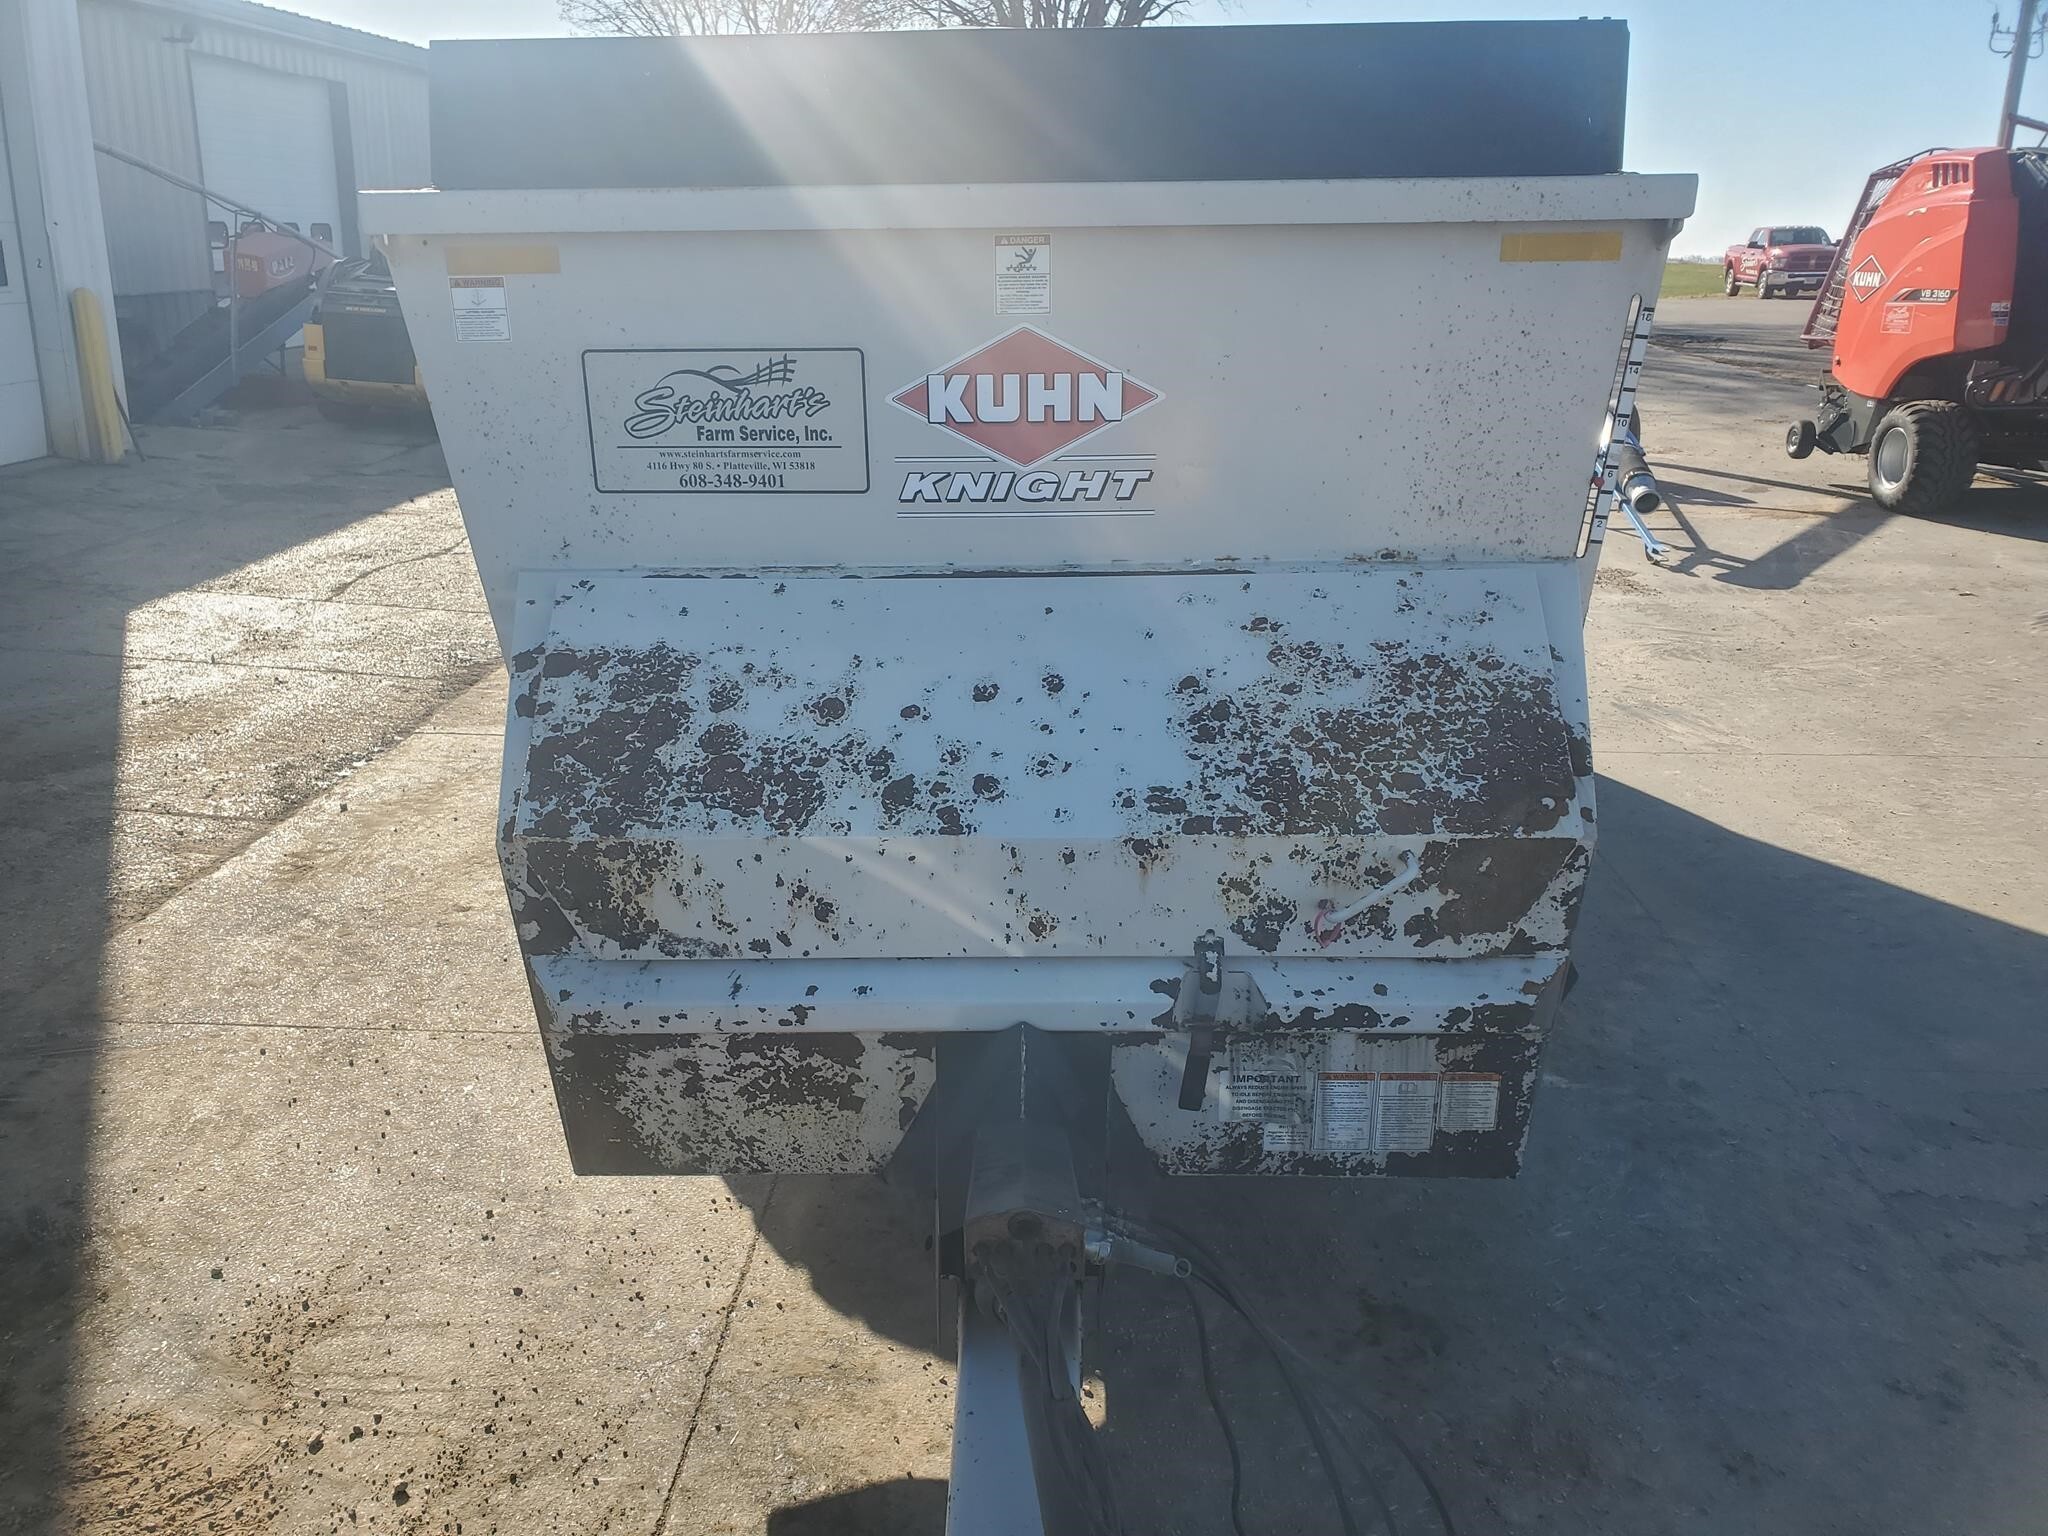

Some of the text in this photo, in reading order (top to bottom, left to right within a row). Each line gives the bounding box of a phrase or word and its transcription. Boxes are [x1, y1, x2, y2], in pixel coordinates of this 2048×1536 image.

[1009, 236, 1045, 245] DANGER
[1852, 271, 1882, 288] KUHN
[1921, 289, 1951, 298] VB 3160
[1628, 366, 1640, 376] 14
[926, 371, 1123, 424] KUHN
[623, 385, 831, 439] Steinhart's
[1616, 419, 1628, 428] 10
[696, 425, 833, 444] Farm Service, Inc.
[659, 449, 802, 459] www.steinhartsfarmservice.com
[646, 461, 816, 473] 4116 Hwy 80 S. Platteville, WI 53818
[1607, 470, 1614, 479] 6
[679, 473, 786, 489] 608-348-9401
[898, 469, 1155, 503] KNIGHT
[1596, 520, 1603, 528] 2
[1232, 1074, 1302, 1084] IMPORTANT
